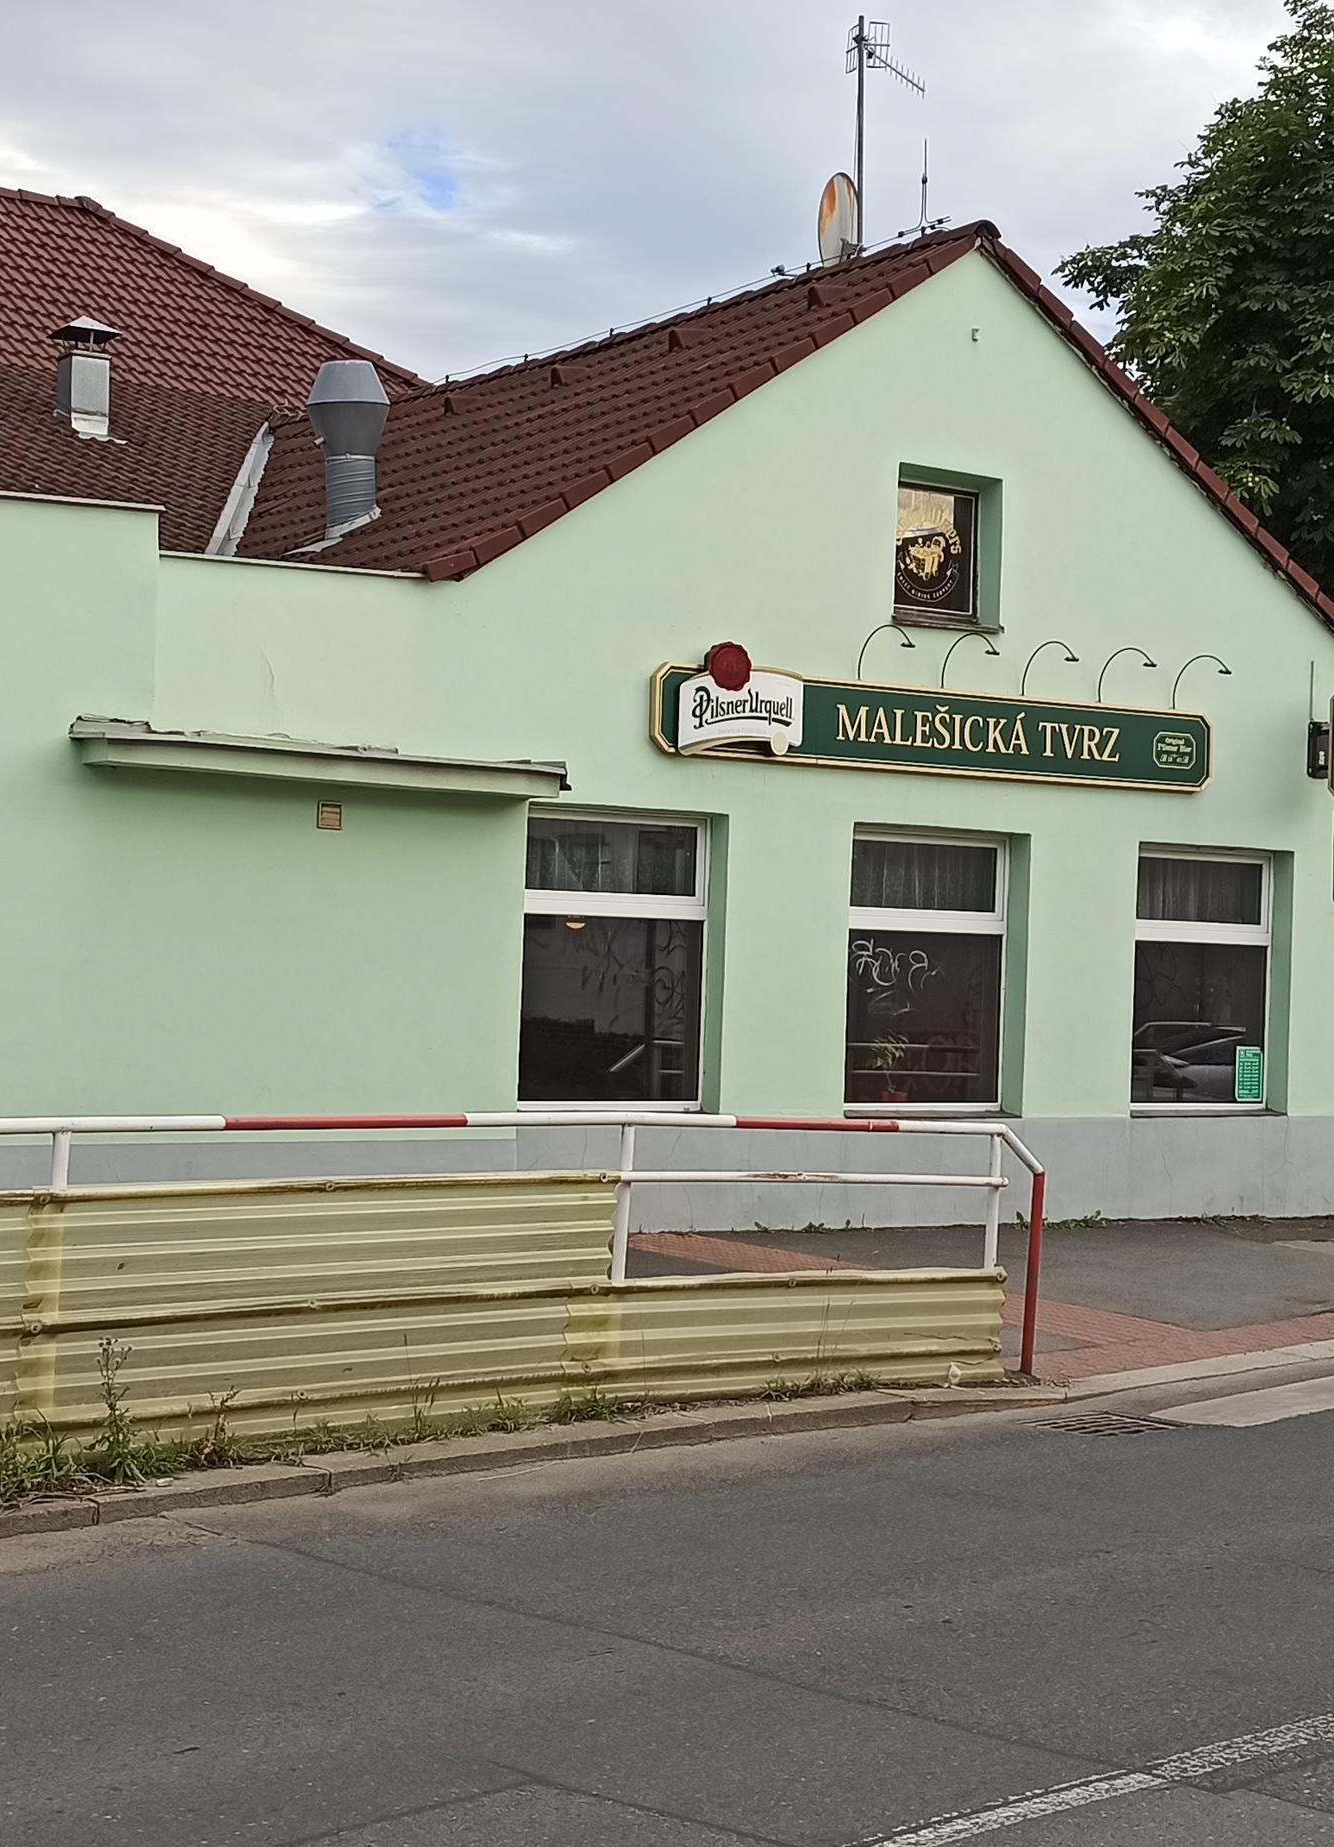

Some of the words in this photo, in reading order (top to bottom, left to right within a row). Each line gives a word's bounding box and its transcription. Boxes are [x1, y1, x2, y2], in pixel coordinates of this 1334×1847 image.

[692, 686, 748, 729] Pilsner
[747, 688, 793, 725] Urquell
[836, 704, 1030, 755] MALEŠICKÁ
[1038, 721, 1121, 763] TVRZ
